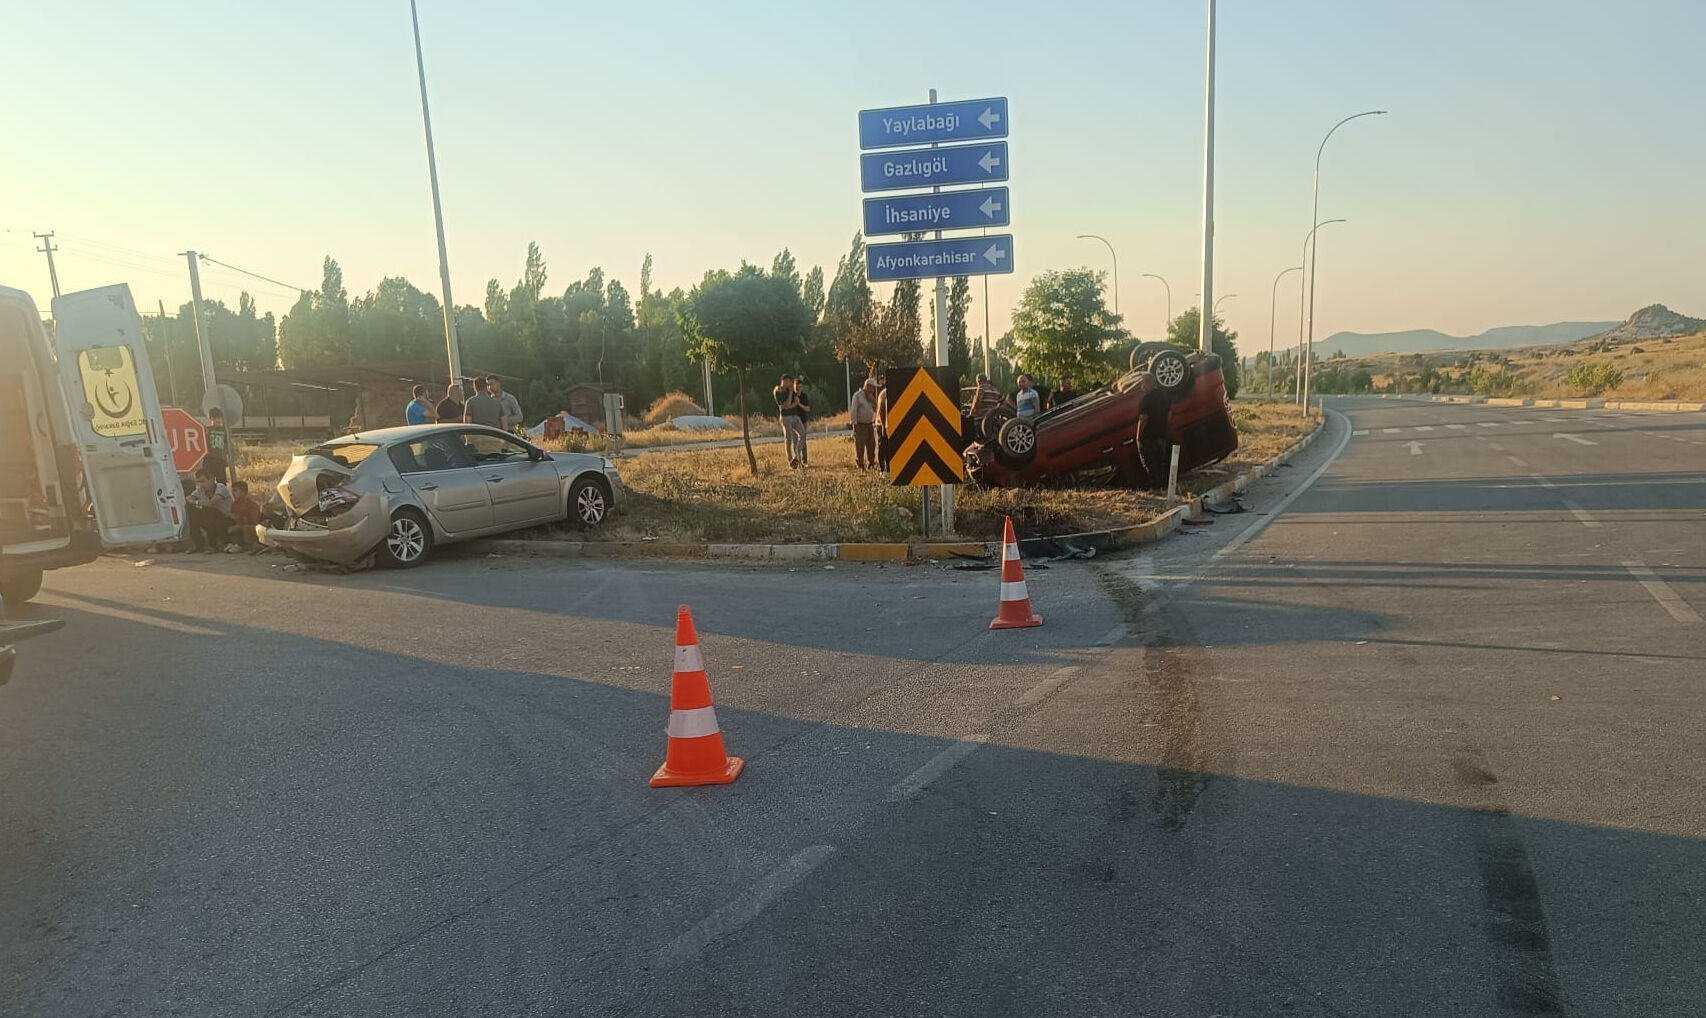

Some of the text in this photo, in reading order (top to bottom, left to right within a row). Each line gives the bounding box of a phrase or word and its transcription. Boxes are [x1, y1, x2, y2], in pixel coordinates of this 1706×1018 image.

[882, 112, 960, 135] Yaylabağı
[883, 157, 948, 177] Gazlıgöl
[885, 205, 951, 224] İhsaniye
[876, 251, 976, 271] Afyonkarahisar
[171, 428, 201, 452] UR
